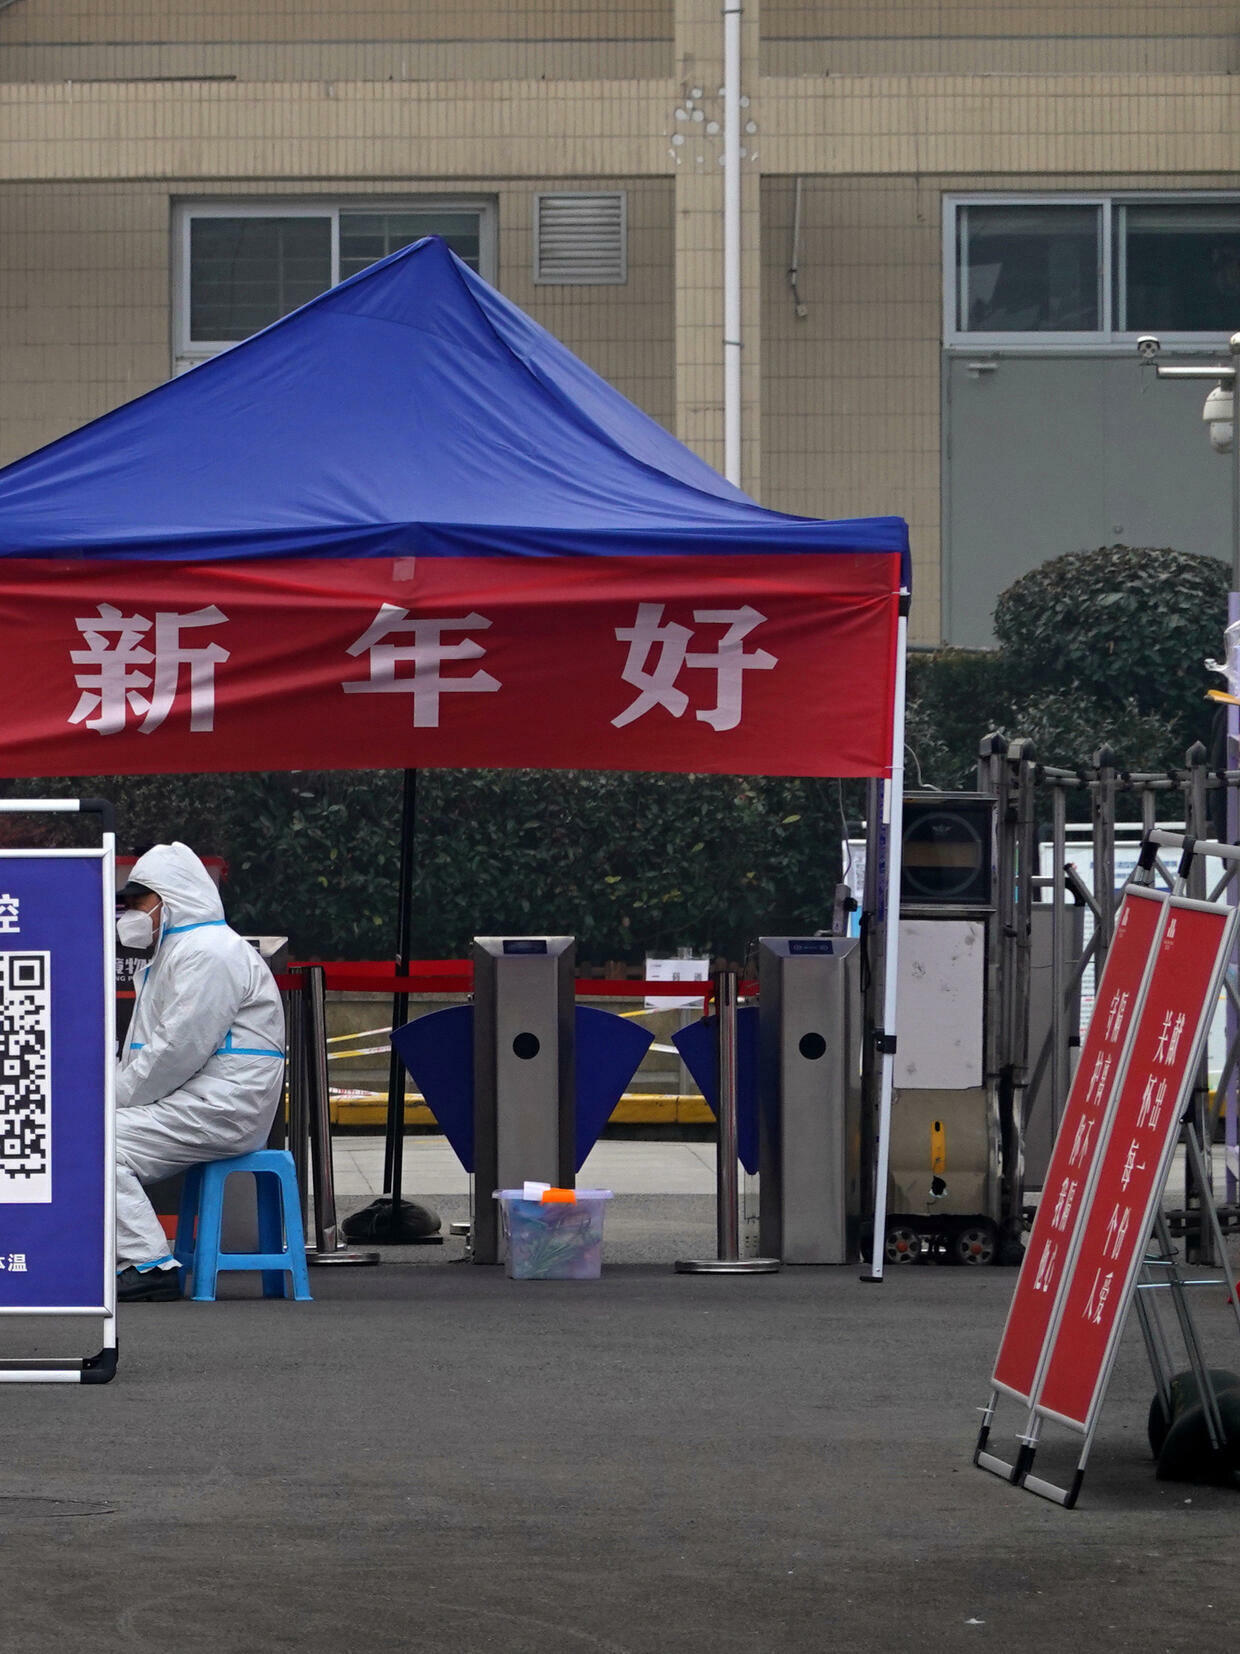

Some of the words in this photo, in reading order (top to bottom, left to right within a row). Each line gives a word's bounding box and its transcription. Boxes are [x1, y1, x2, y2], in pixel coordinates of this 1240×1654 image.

[67, 602, 779, 736] 新年好
[1081, 1010, 1174, 1321] 关怀每个人
[1092, 1011, 1186, 1325] 献出一份爱
